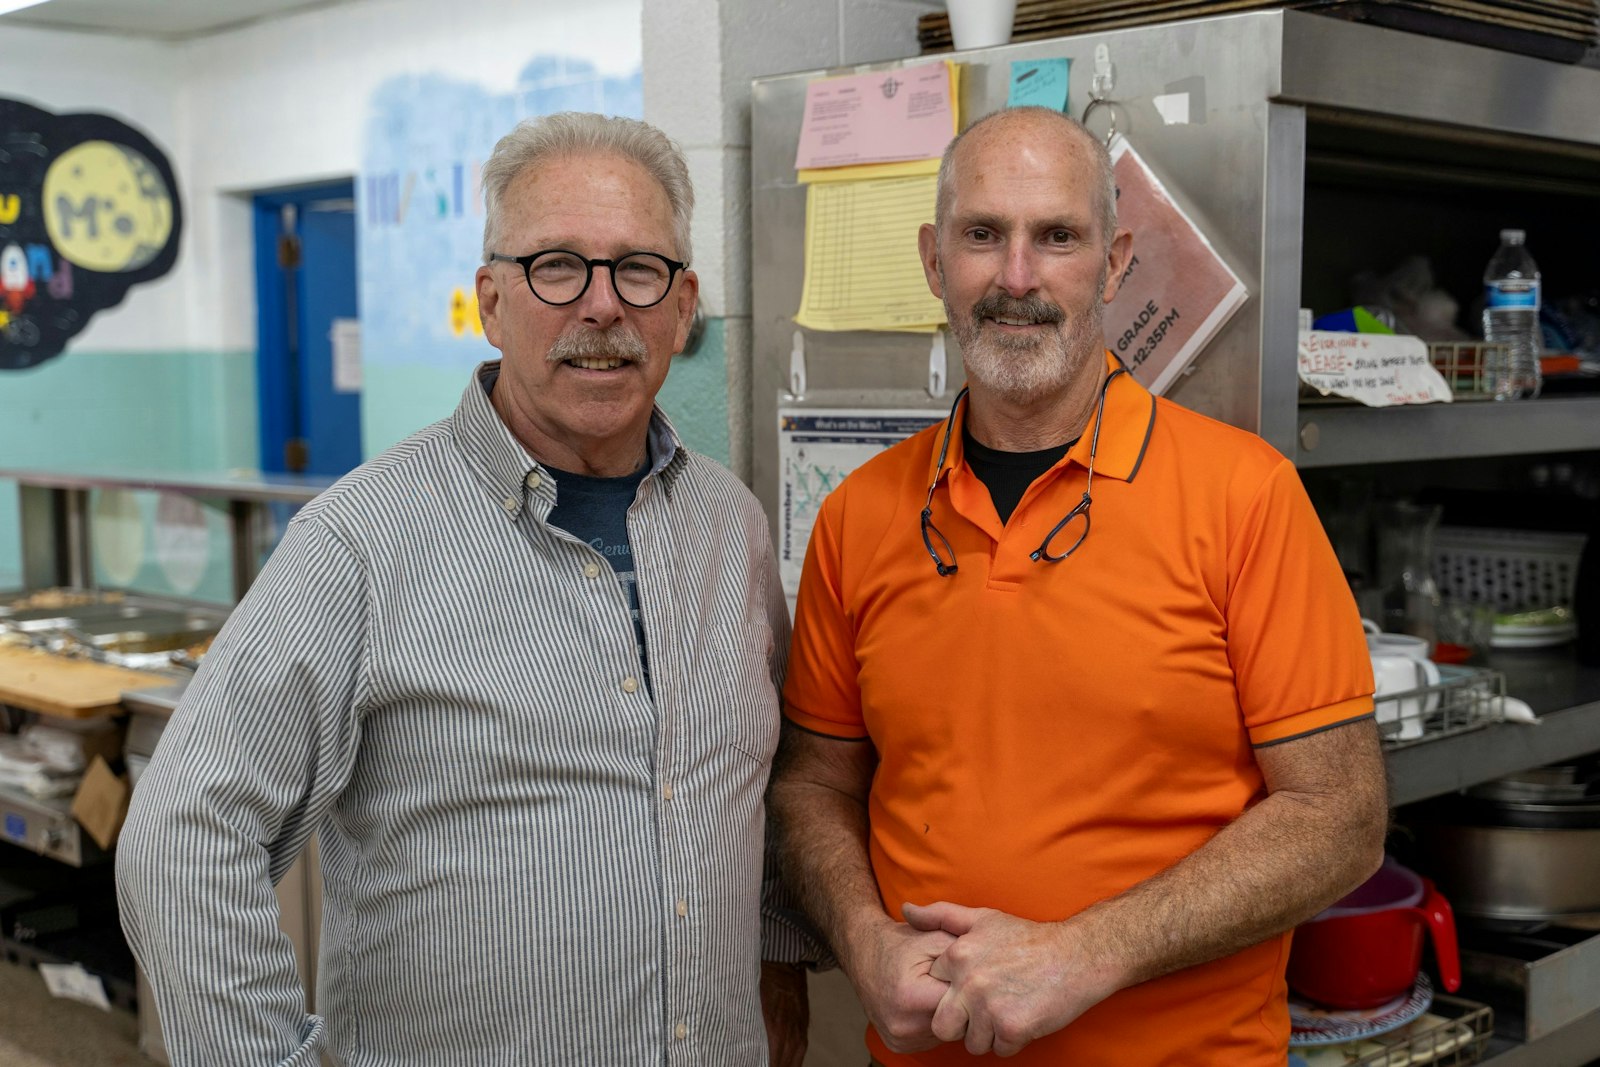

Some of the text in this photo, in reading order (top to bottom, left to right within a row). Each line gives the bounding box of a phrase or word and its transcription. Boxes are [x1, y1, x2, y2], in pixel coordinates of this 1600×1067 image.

[1117, 299, 1159, 351] GRADE
[1129, 307, 1180, 373] -12:35PM
[783, 482, 792, 561] November
